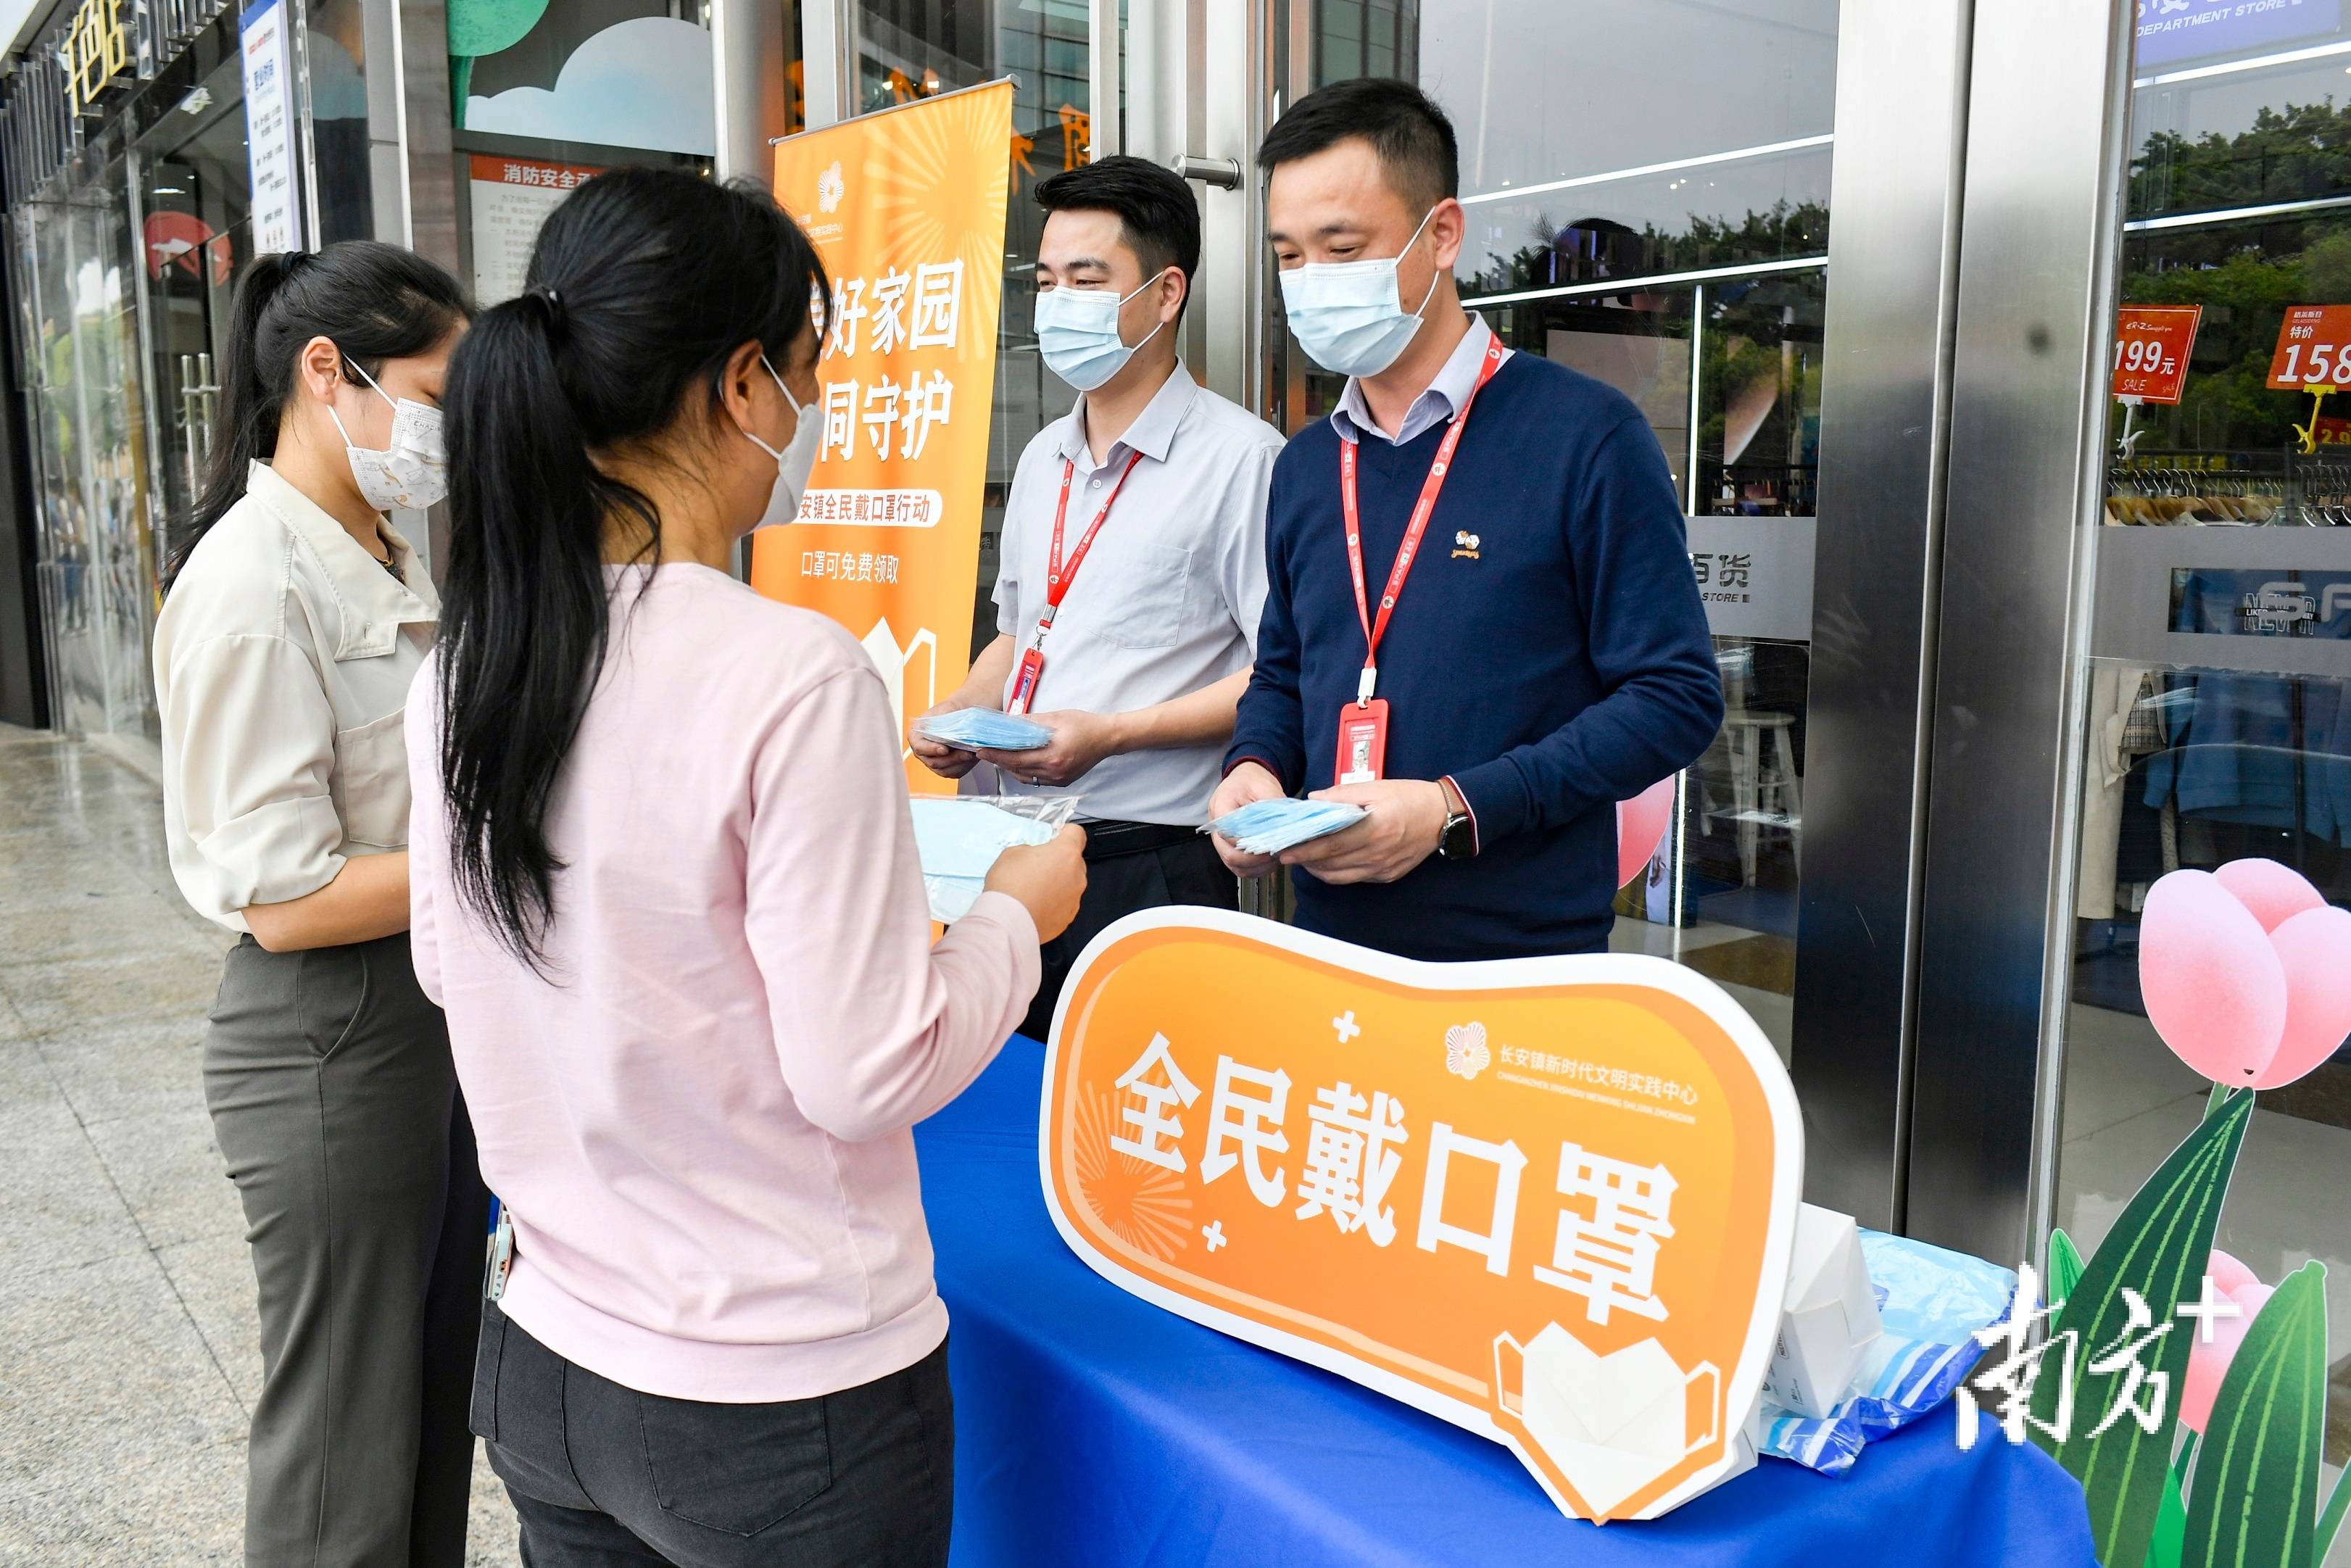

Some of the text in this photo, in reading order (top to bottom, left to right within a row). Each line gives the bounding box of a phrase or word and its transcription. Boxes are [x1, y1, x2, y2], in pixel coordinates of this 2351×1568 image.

[2137, 8, 2231, 36] DEPARTMENT
[2235, 0, 2286, 17] STORE
[2289, 325, 2313, 339] 特价
[2277, 344, 2351, 383] 158
[2122, 378, 2147, 391] SALE
[821, 368, 955, 462] 同守护
[801, 551, 900, 584] 口罩可免费领取
[1701, 592, 1739, 602] STORE
[1499, 1044, 1699, 1106] 长安镇新时代文明实践中心
[1111, 1031, 1680, 1327] 全民戴口罩
